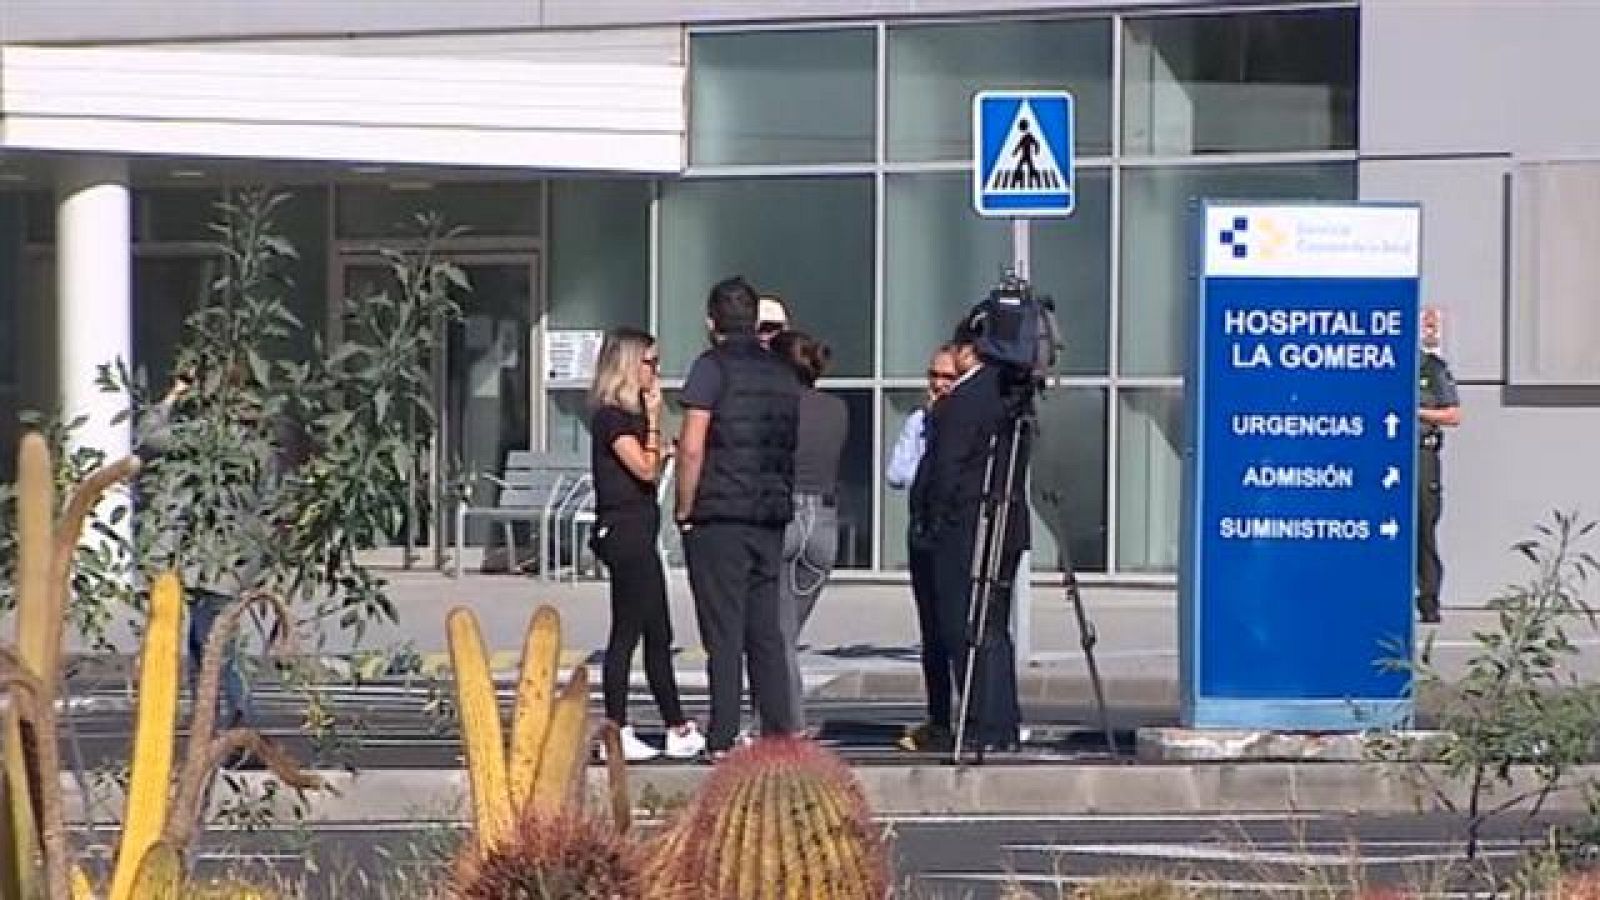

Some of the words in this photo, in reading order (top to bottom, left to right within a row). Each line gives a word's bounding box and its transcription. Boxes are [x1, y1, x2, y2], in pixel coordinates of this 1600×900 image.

[1224, 310, 1365, 335] HOSPITAL
[1371, 310, 1401, 335] DE
[1232, 345, 1272, 368] LA
[1279, 345, 1396, 369] GOMERA
[1233, 414, 1364, 436] URGENCIAS
[1242, 464, 1353, 487] ADMISIÓN
[1219, 516, 1371, 538] SUMINISTROS
